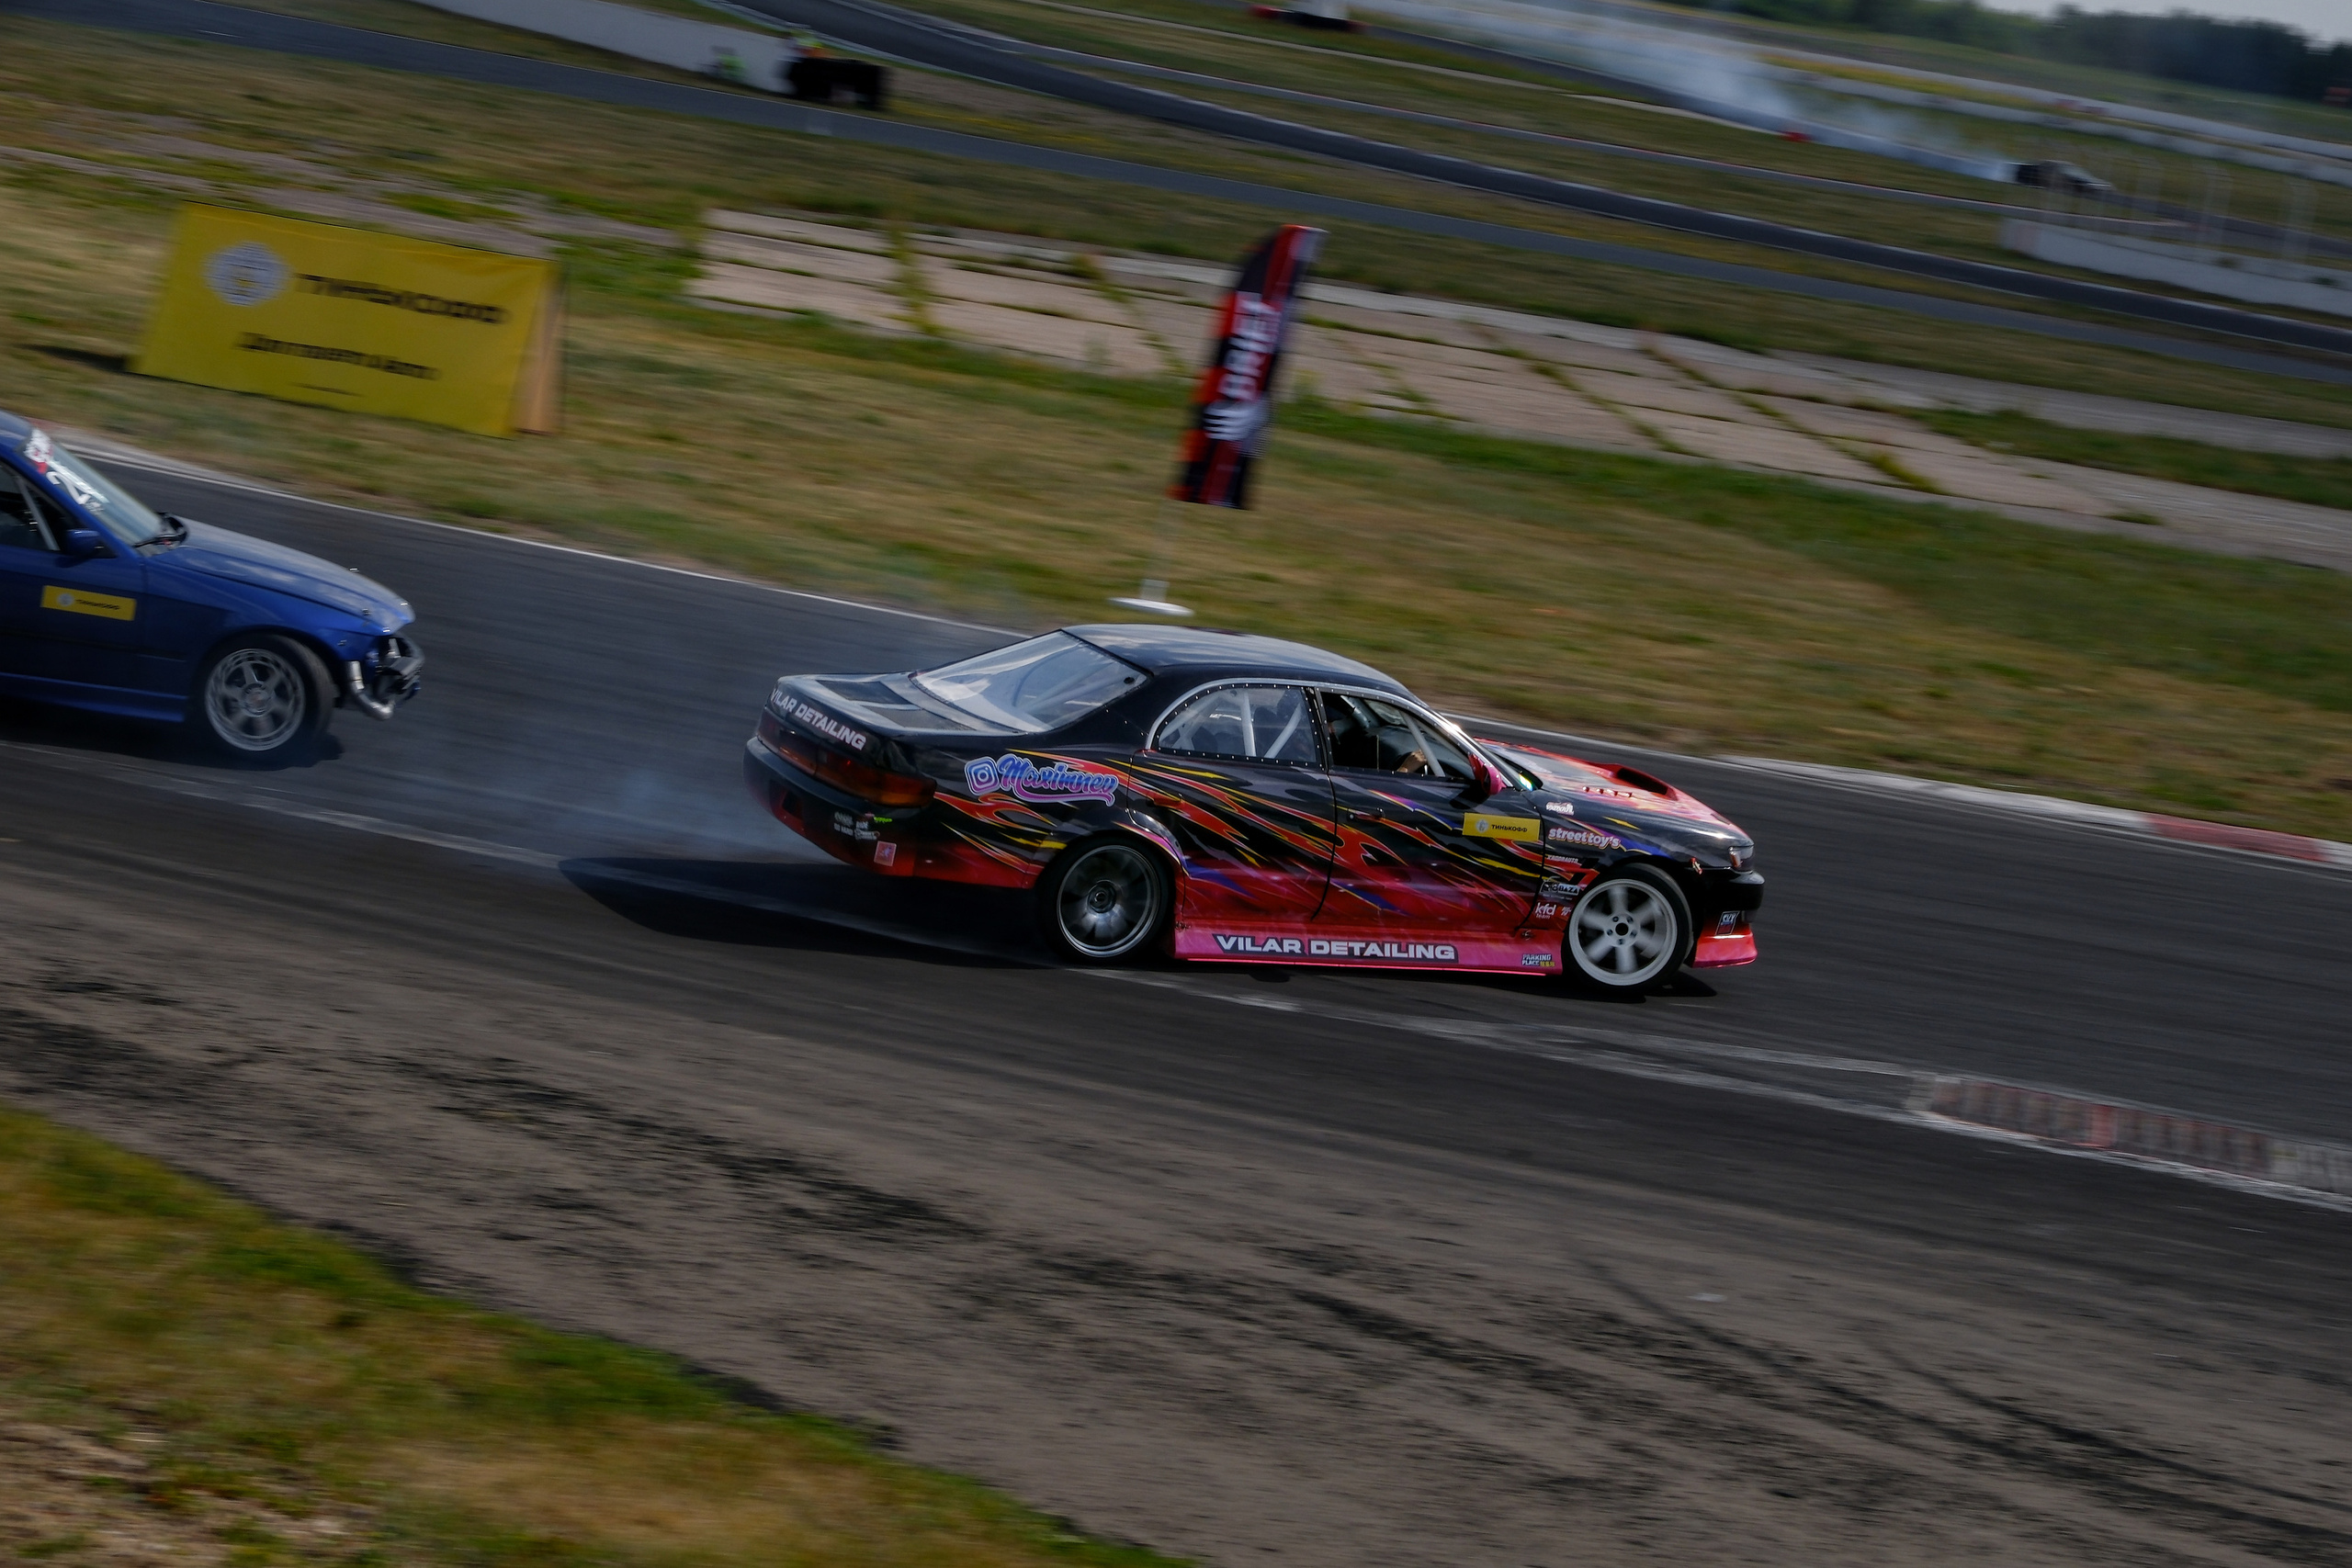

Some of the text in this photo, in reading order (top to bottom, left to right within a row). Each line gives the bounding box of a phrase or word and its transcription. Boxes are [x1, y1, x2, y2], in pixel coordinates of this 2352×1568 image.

[770, 688, 866, 751] VILAR DETAILING
[1535, 902, 1556, 916] kfd
[1216, 935, 1455, 960] VILAR DETAILING
[1522, 953, 1552, 962] PARKING
